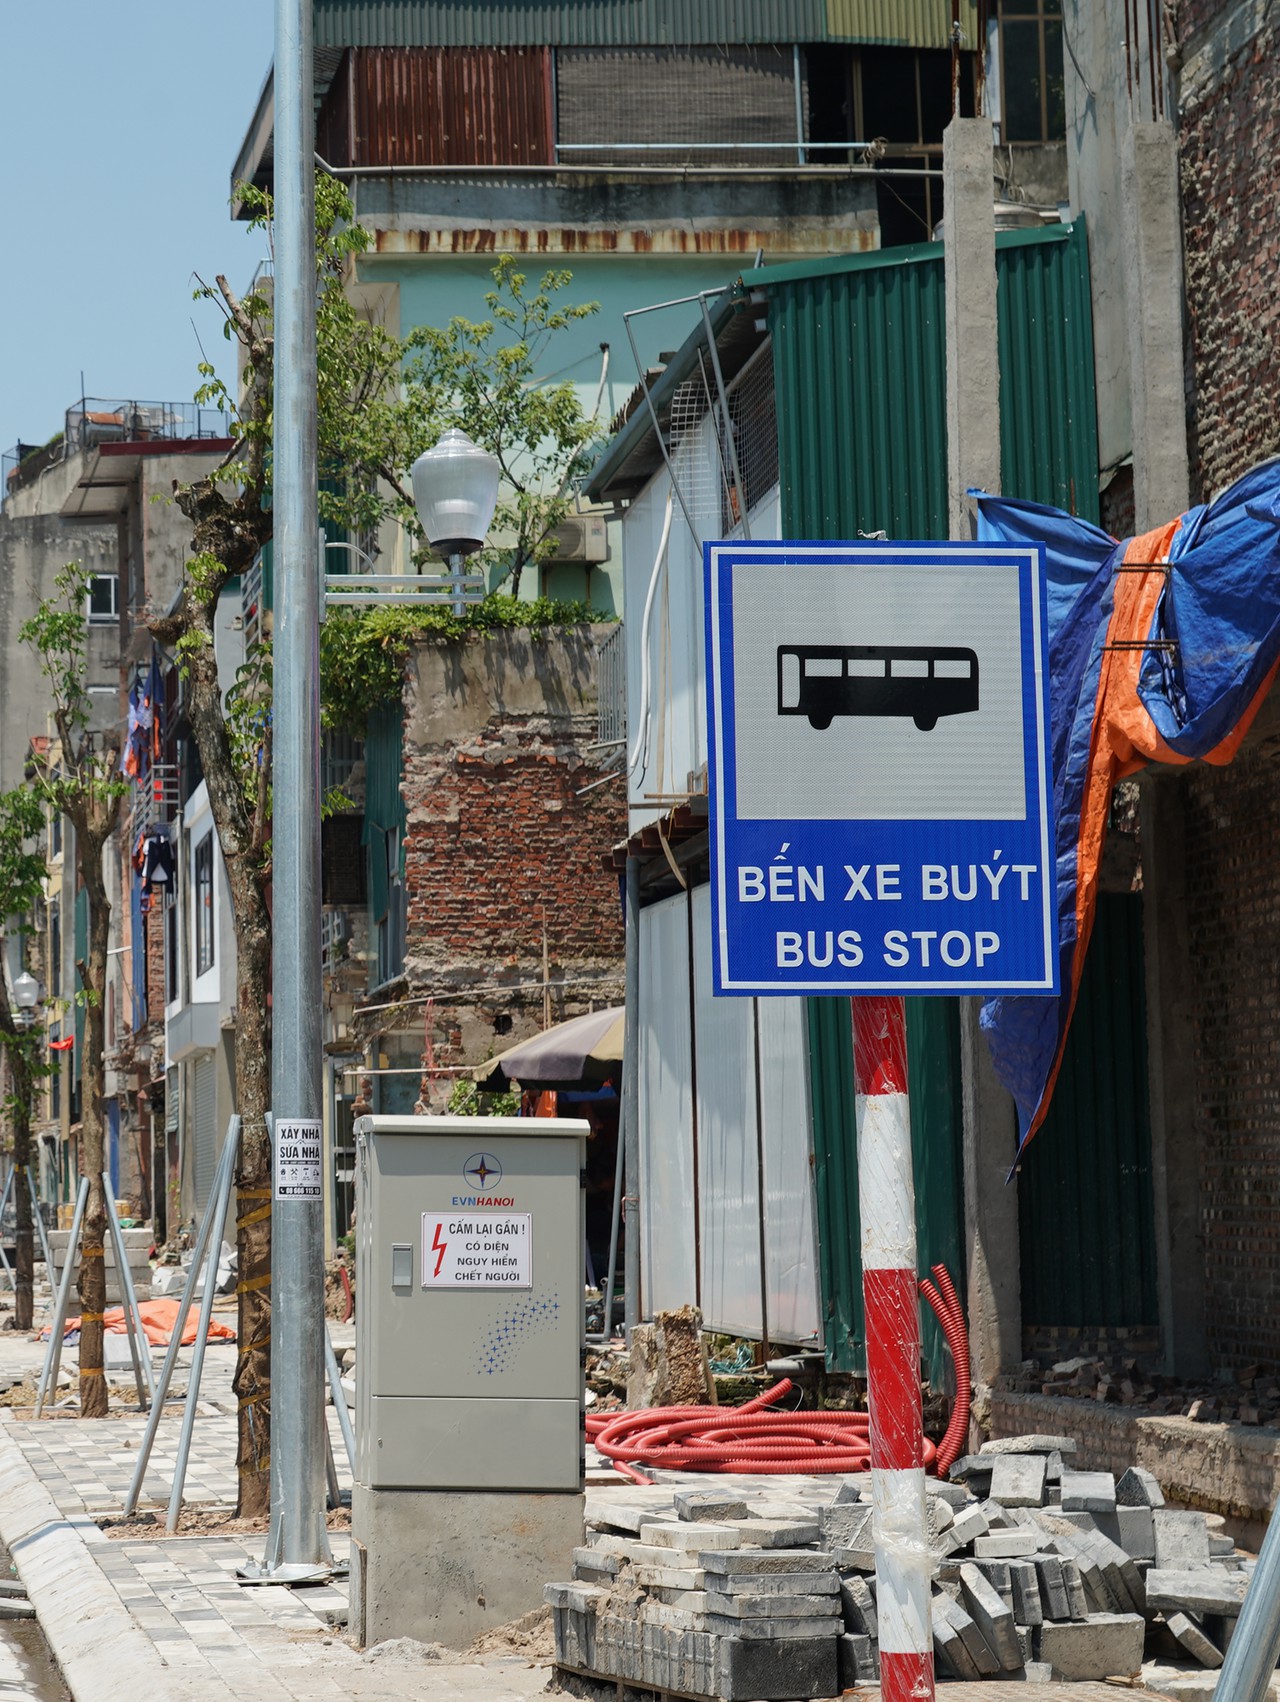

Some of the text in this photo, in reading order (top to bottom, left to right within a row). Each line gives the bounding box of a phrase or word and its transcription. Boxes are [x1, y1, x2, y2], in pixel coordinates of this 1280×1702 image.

[737, 842, 1038, 903] BẾN XE BUÝT
[775, 930, 1001, 968] BUS STOP
[280, 1125, 320, 1140] XÂY NHÀ
[301, 1144, 320, 1159] NHÀ
[452, 1196, 515, 1207] EVNHANOI
[448, 1218, 473, 1235] CẤM
[476, 1223, 492, 1238] LẠI
[465, 1240, 509, 1254] CÓ ĐIỆN
[457, 1253, 517, 1266] NGUY HIỂM
[454, 1269, 520, 1281] CHẾT NGƯỜI
